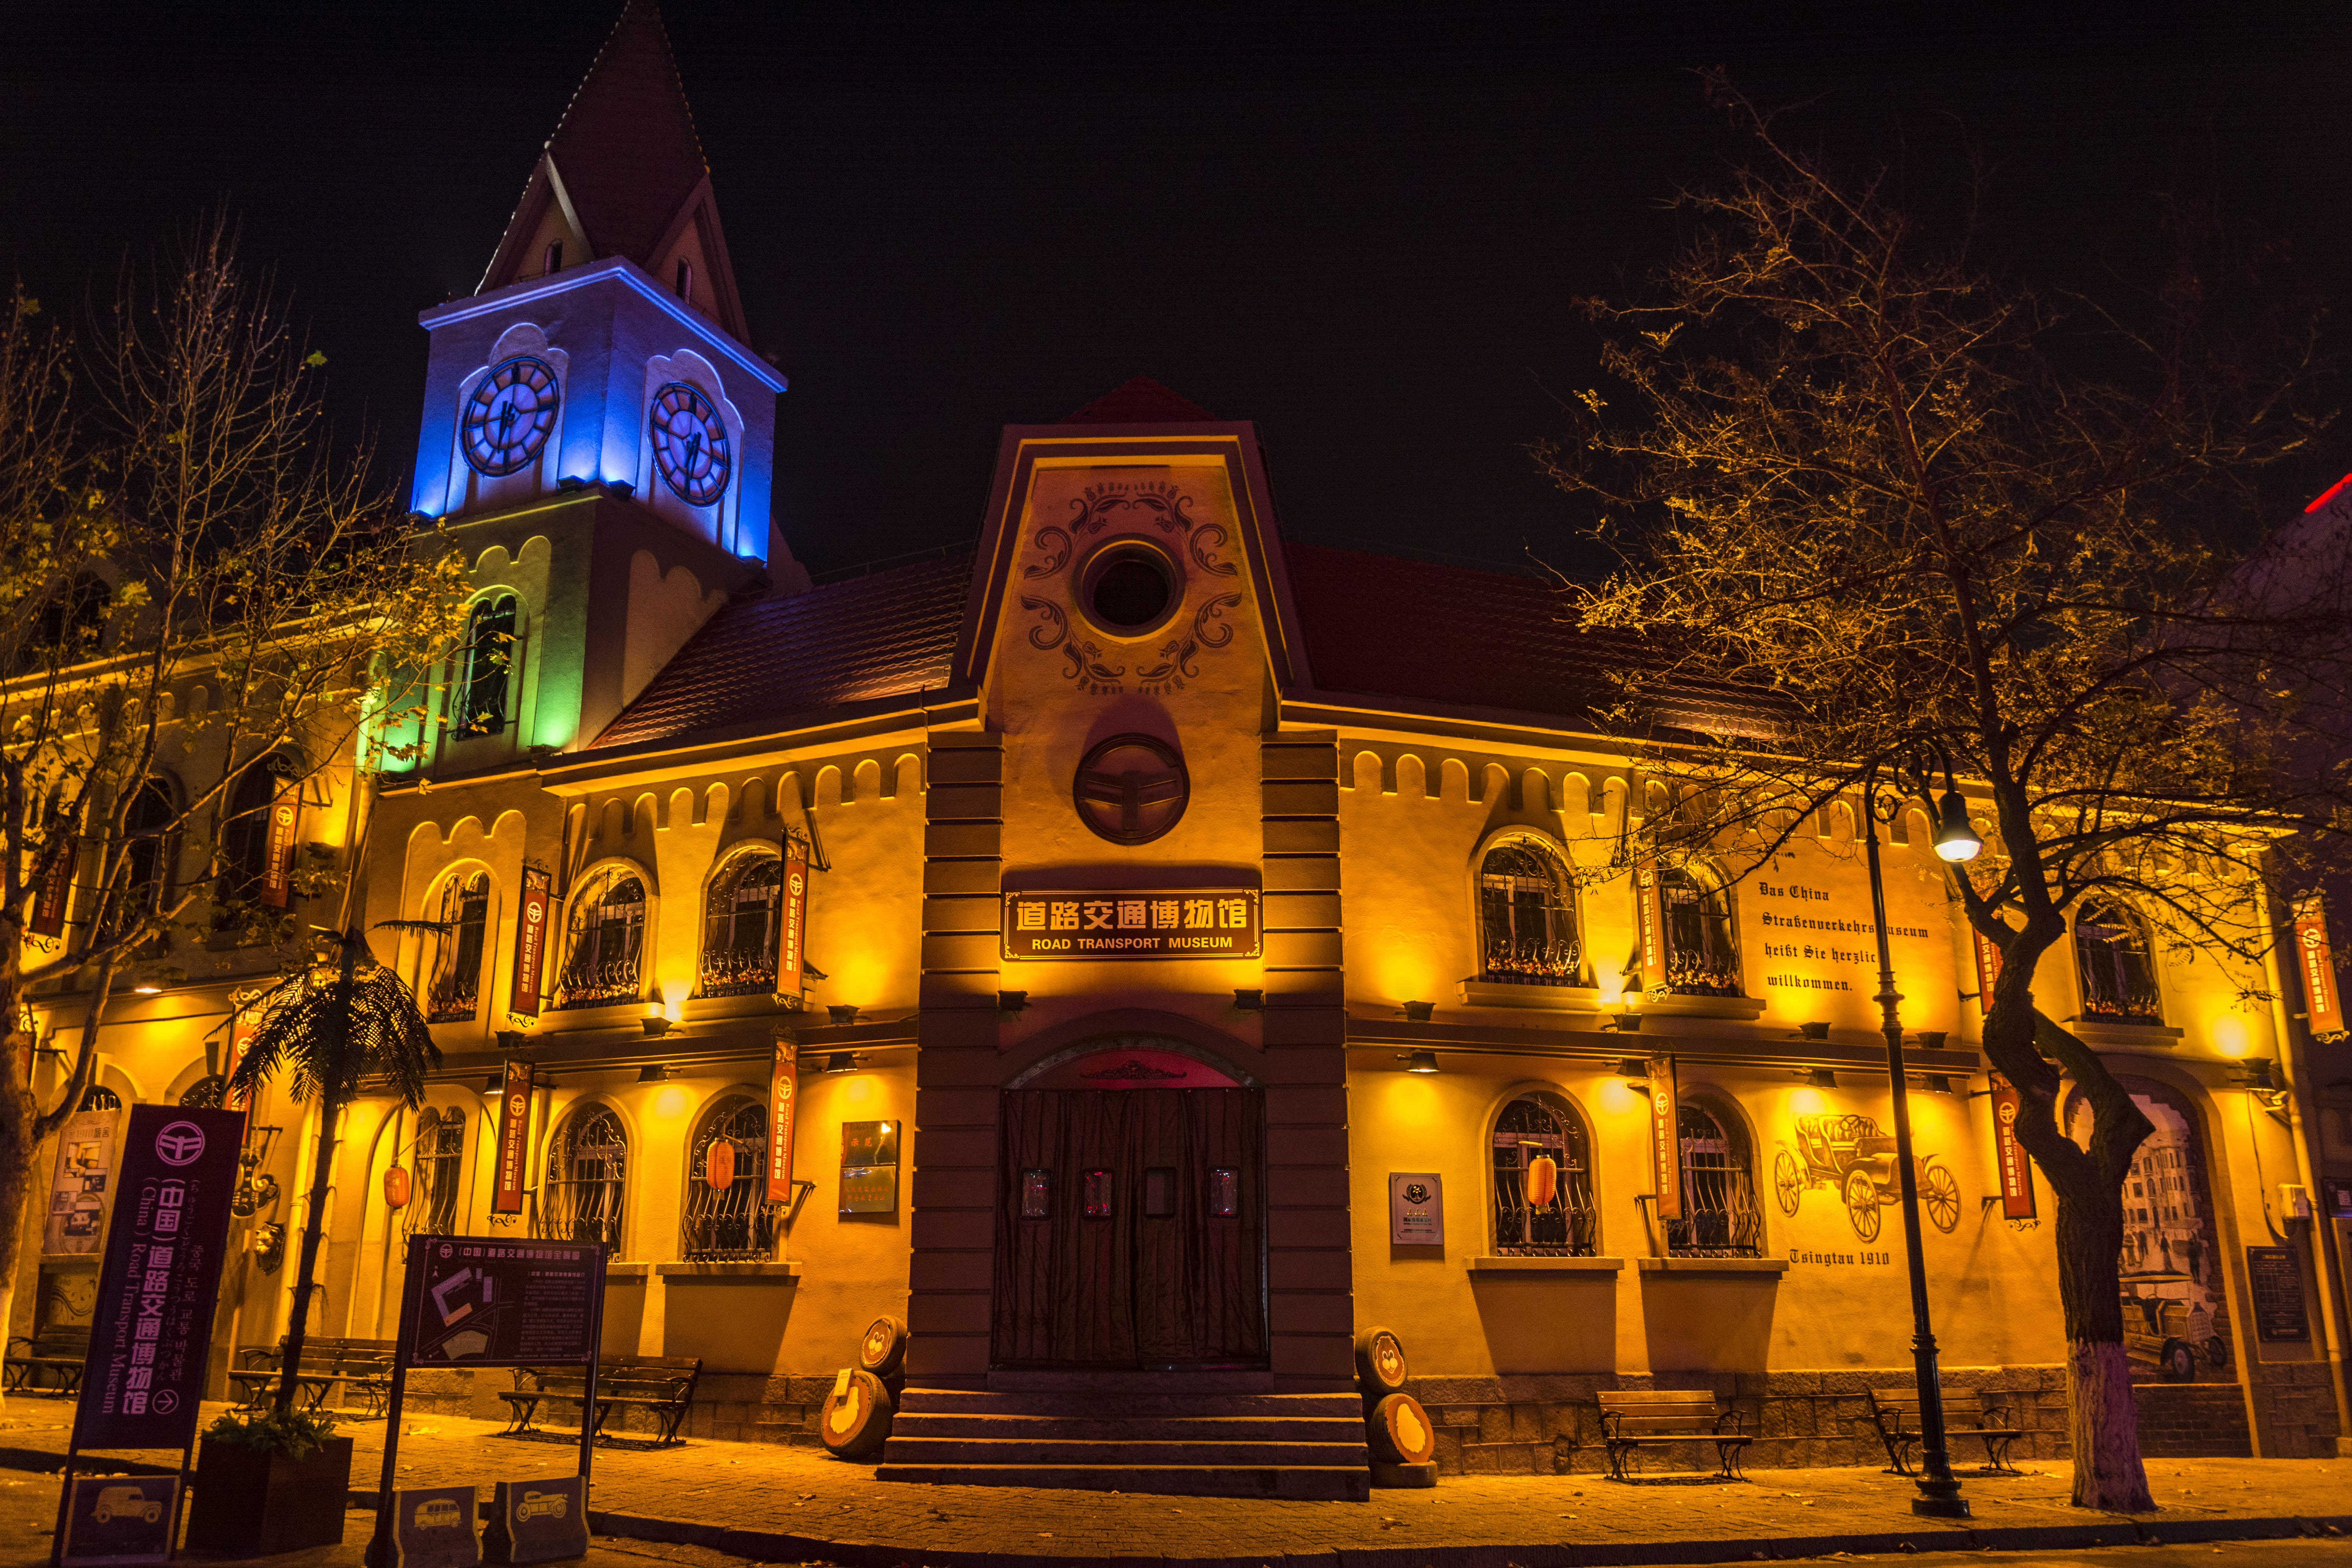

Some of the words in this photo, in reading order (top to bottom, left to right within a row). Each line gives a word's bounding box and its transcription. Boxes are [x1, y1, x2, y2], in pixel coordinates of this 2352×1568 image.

[1759, 882, 1784, 897] Das
[1789, 885, 1829, 901] China
[1016, 898, 1247, 931] 道路交通博物馆
[1643, 894, 1653, 966] 道路交通博物馆
[1762, 912, 1928, 938] Straßenverkehrsuseum
[786, 897, 796, 971] 道路交通博物馆
[1032, 938, 1071, 949] ROAD
[1078, 938, 1161, 949] TRANSPORT
[1169, 936, 1232, 948] MUSEUM
[522, 924, 534, 993] 道路交通博物馆
[1765, 943, 1797, 958] heißt
[1804, 945, 1826, 959] Sie
[1832, 948, 1878, 964] herzlic
[1768, 975, 1853, 991] willkommen.
[504, 1119, 517, 1191] 道路交通博物馆
[774, 1102, 784, 1179] 道路交通博物馆
[1658, 1119, 1668, 1194] 道路交通博物馆
[2002, 1126, 2017, 1196] 道路交通博物馆
[127, 1243, 147, 1279] Road
[192, 1244, 204, 1272] 중국
[1789, 1249, 1854, 1267] Tsingtau
[1860, 1252, 1889, 1265] 1910
[183, 1277, 198, 1301] 도로
[114, 1285, 140, 1348] Transport
[177, 1308, 193, 1336] 교통
[170, 1339, 189, 1381] 박물관
[102, 1353, 126, 1414] Museum
